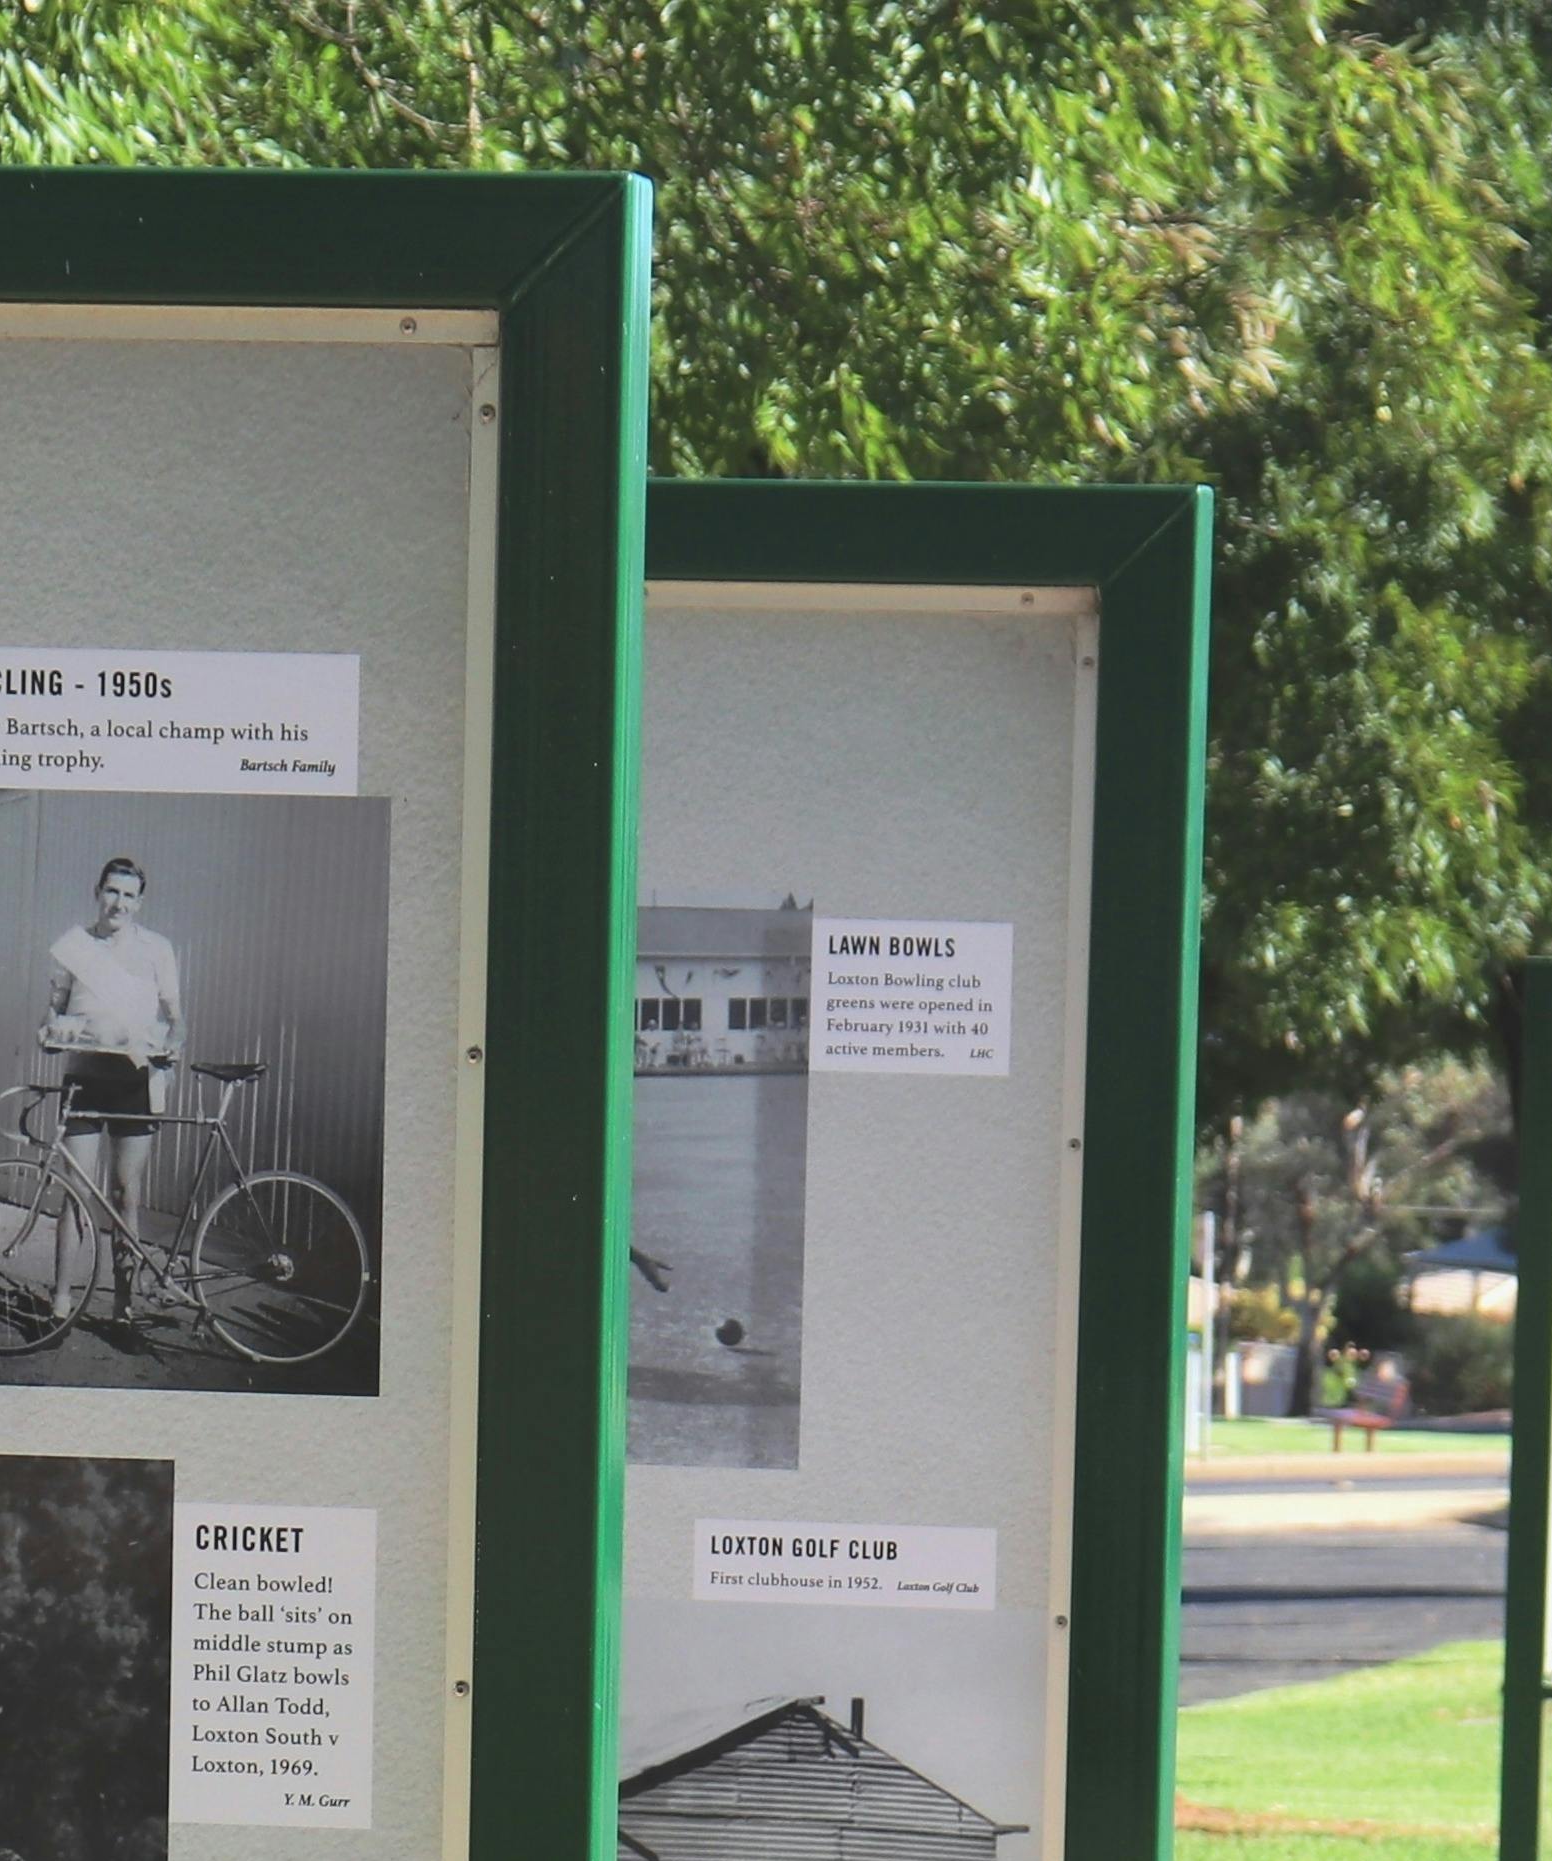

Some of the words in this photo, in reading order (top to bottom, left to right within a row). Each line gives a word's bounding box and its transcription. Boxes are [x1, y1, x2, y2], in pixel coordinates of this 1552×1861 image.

[97, 670, 172, 699] 1950s
[5, 717, 84, 739] Bartsch,
[89, 724, 101, 737] a
[106, 718, 153, 739] local
[158, 719, 225, 745] champ
[230, 721, 274, 741] with
[279, 722, 309, 742] his
[37, 749, 104, 774] trophy.
[239, 757, 288, 773] Bartsch
[290, 758, 336, 778] Family
[828, 934, 880, 956] LAWN
[888, 935, 955, 958] BOWLS
[827, 970, 879, 987] Loxton
[883, 972, 945, 992] Bowling
[947, 973, 981, 989] club
[825, 998, 876, 1013] greens
[878, 999, 915, 1011] were
[917, 997, 974, 1016] opened
[977, 997, 993, 1013] in
[826, 1016, 894, 1037] February
[898, 1019, 928, 1035] 1931
[933, 1019, 967, 1036] with
[970, 1021, 989, 1036] 40
[824, 1041, 868, 1056] active
[871, 1042, 945, 1058] members.
[968, 1047, 994, 1060] LHC
[195, 1523, 304, 1554] CRICKET
[710, 1534, 783, 1557] LOXTON
[791, 1537, 840, 1559] GOLF
[848, 1539, 898, 1561] CLUB
[193, 1571, 250, 1592] Clean
[256, 1573, 333, 1594] bowled!
[709, 1570, 744, 1585] First
[746, 1571, 824, 1588] clubhouse
[827, 1574, 843, 1589] in
[847, 1575, 883, 1590] 1952.
[896, 1580, 931, 1592] Loxton
[931, 1581, 955, 1595] Golf
[955, 1582, 980, 1594] Club
[192, 1602, 232, 1621] The
[237, 1602, 274, 1623] ball
[327, 1611, 353, 1625] on
[192, 1632, 261, 1653] middle
[266, 1639, 328, 1660] stump
[332, 1642, 353, 1656] as
[192, 1662, 231, 1682] Phil
[236, 1664, 288, 1684] Glatz
[292, 1665, 350, 1686] bowls
[191, 1697, 211, 1712] to
[215, 1694, 269, 1714] Allan
[273, 1696, 330, 1718] Todd,
[191, 1724, 259, 1744] Loxton
[264, 1726, 323, 1746] South
[327, 1734, 339, 1746] v
[191, 1754, 264, 1777] Loxton,
[270, 1758, 318, 1777] 1969.
[284, 1792, 295, 1806] Y.
[297, 1793, 315, 1807] M.
[318, 1793, 351, 1808] Gurr
